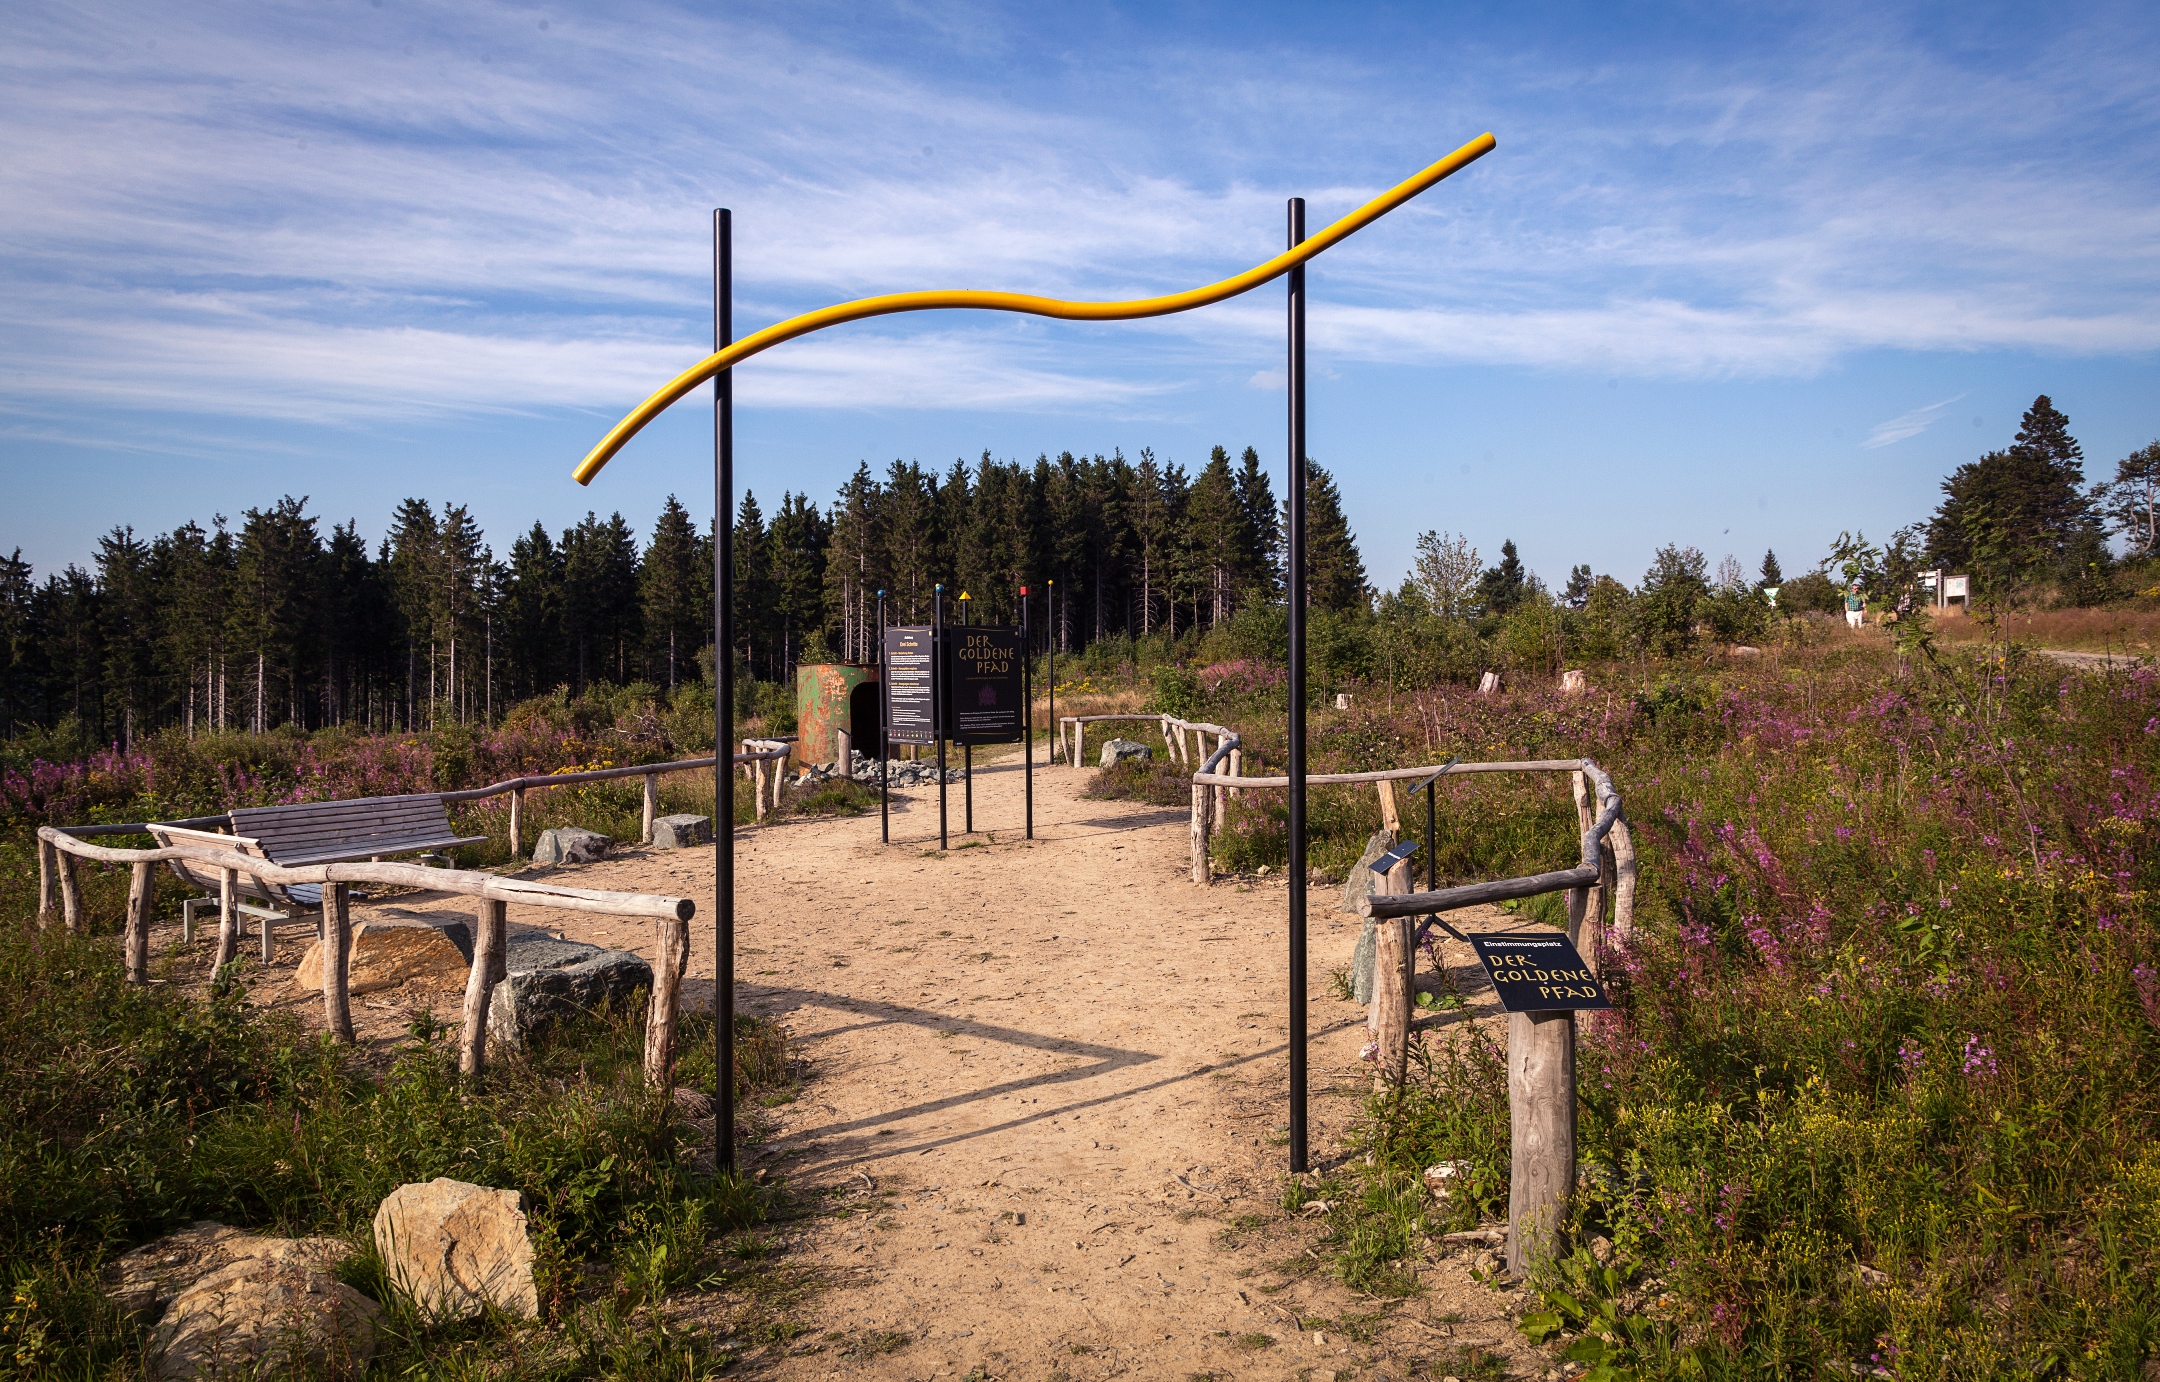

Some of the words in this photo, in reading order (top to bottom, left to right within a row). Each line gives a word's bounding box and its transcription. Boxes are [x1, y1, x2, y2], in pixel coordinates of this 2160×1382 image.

[967, 635, 993, 648] DER
[958, 647, 1015, 661] GOLDENE
[977, 661, 1009, 674] PFAD
[1488, 954, 1537, 967] DER
[1493, 969, 1593, 983] GOLDENE
[1538, 986, 1597, 1000] PFAD
